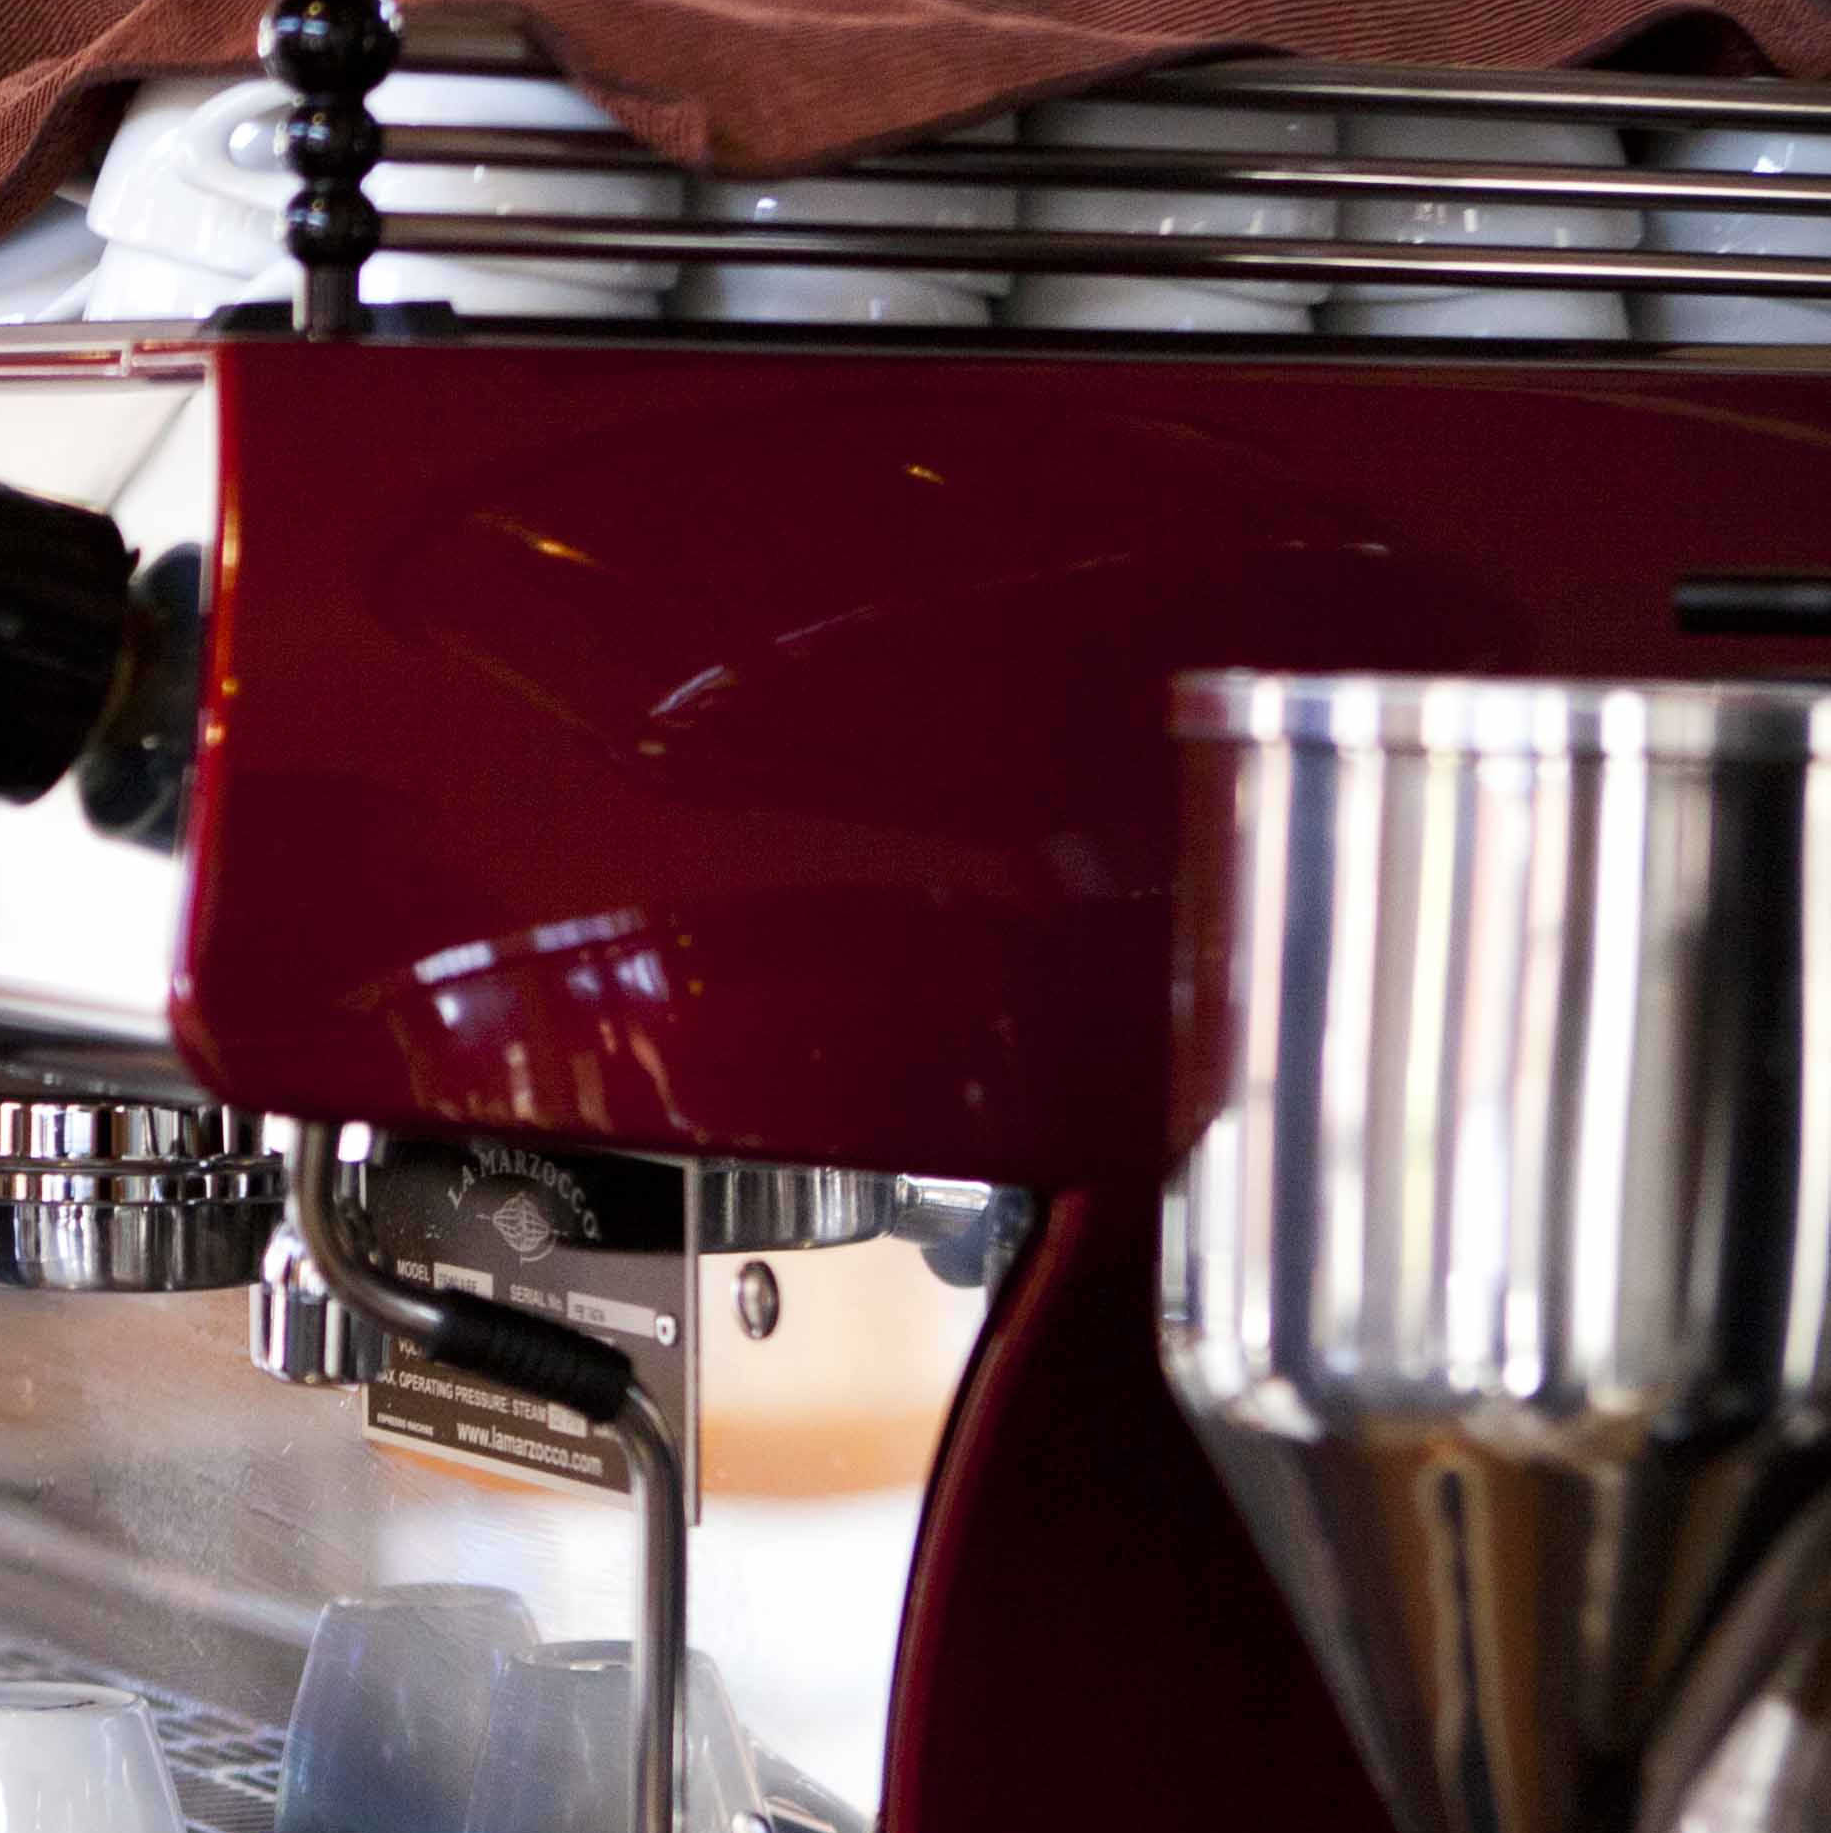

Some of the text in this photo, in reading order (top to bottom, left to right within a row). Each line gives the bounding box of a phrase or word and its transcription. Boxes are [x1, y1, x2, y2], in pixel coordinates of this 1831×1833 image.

[447, 1148, 602, 1241] LA MARZOCCO
[396, 1259, 431, 1283] MODEL
[398, 1370, 454, 1400] OPERATING
[456, 1421, 603, 1476] www.lamarzocco.com
